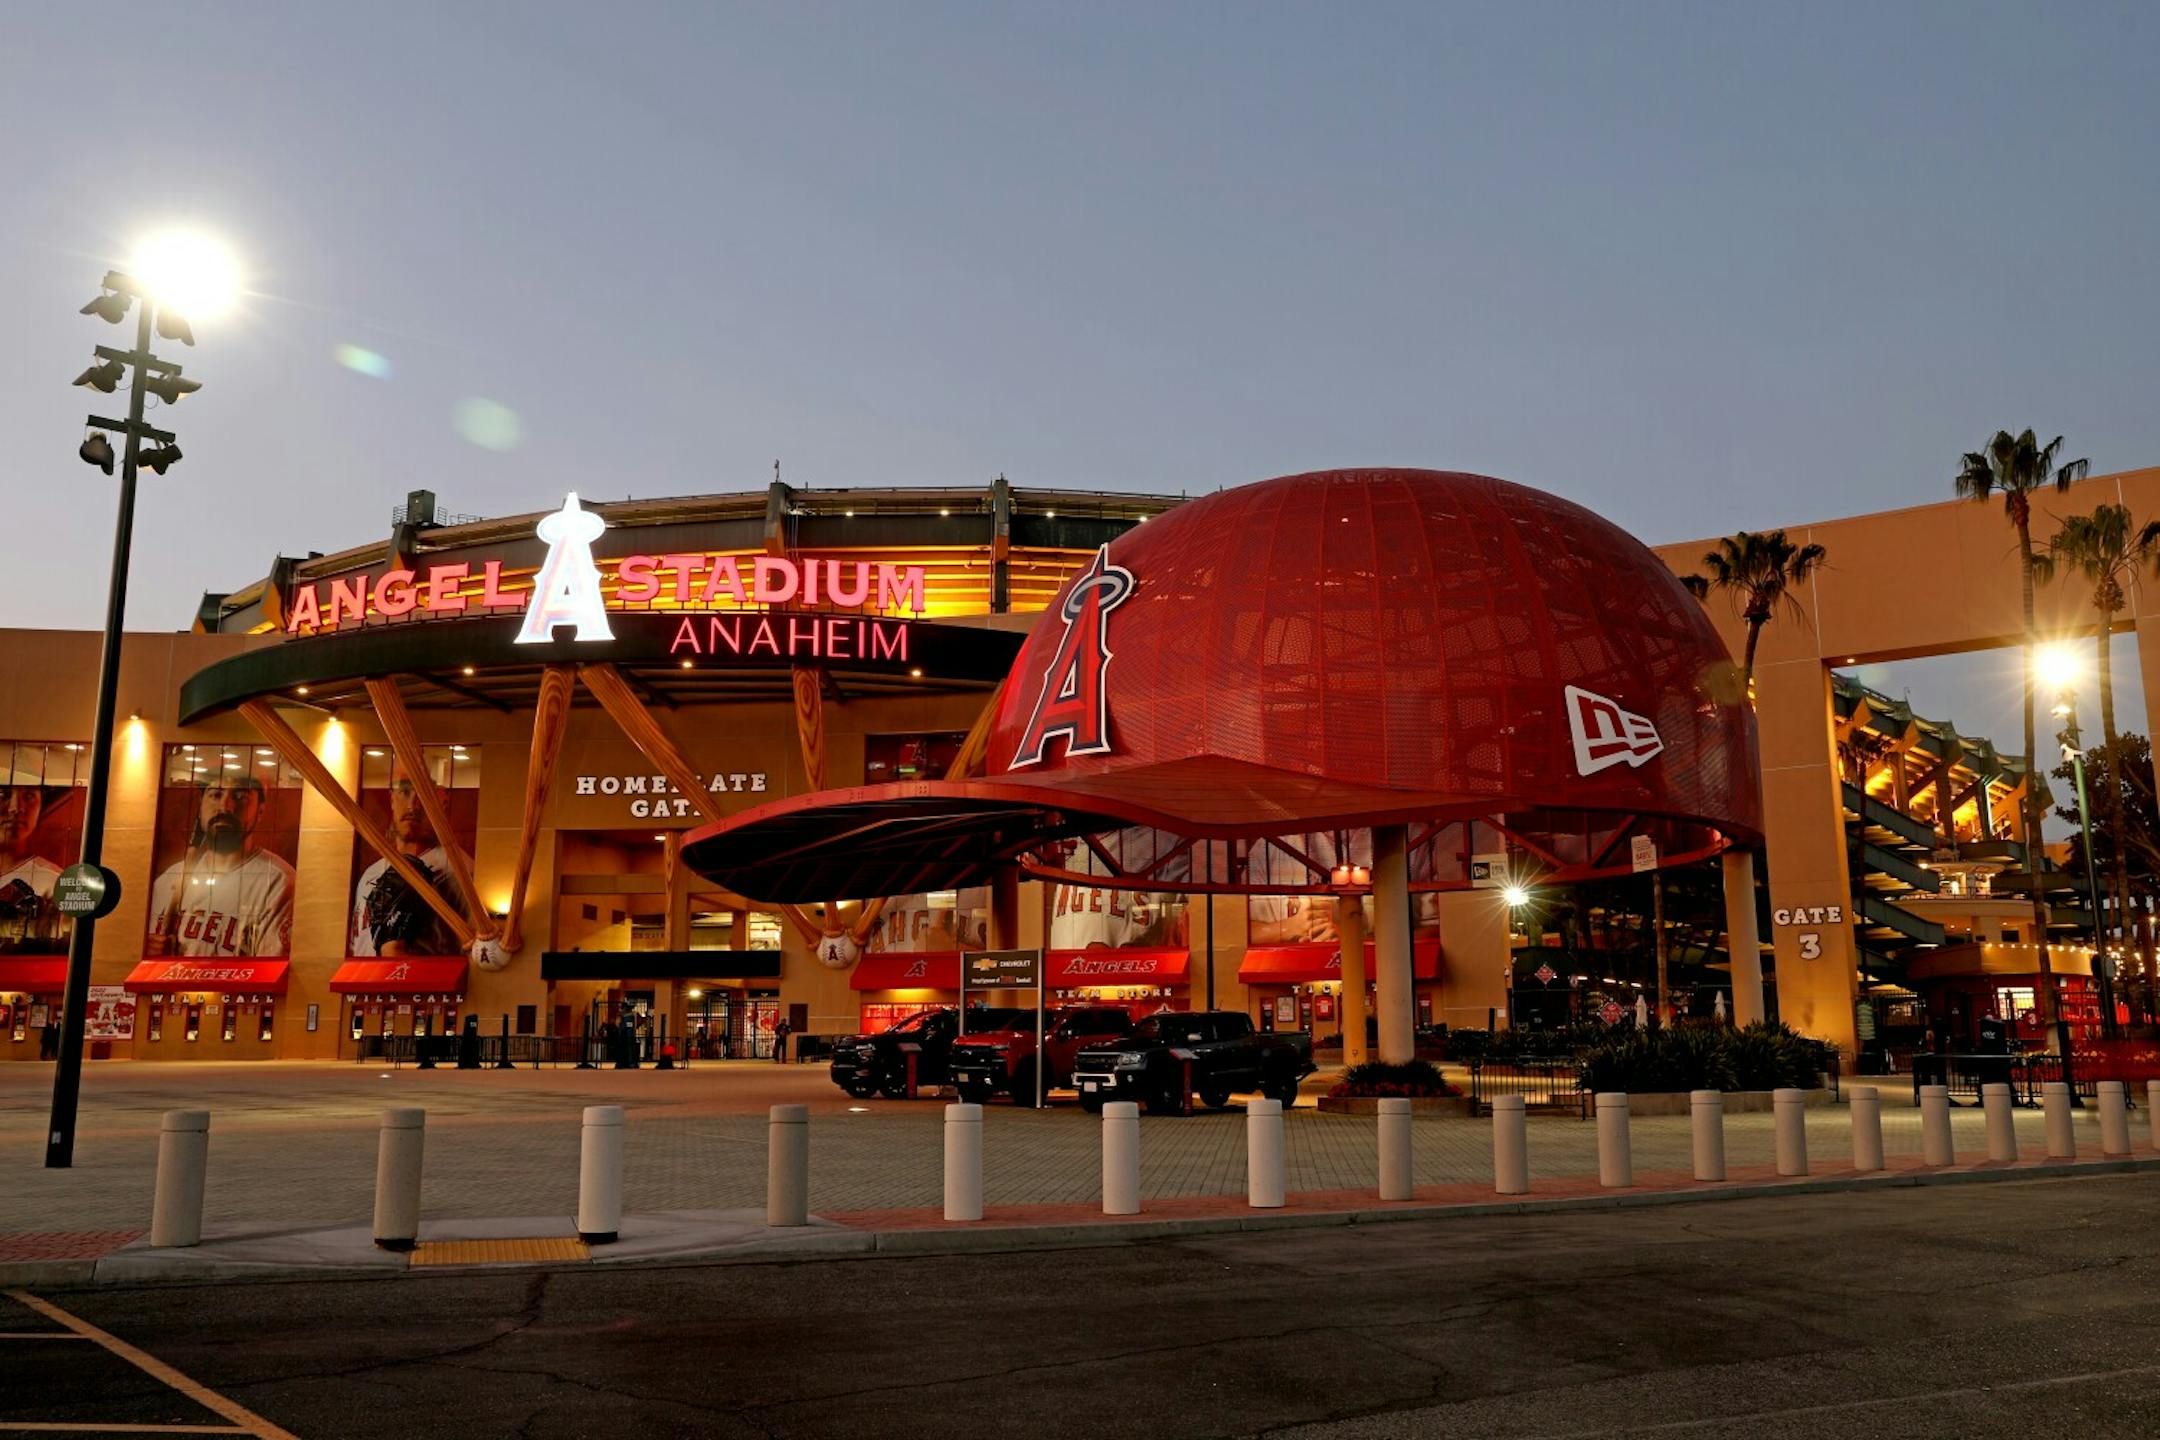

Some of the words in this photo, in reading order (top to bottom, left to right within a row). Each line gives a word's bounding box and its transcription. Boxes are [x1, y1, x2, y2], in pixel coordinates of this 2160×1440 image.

[286, 560, 528, 634] ANGEL
[615, 554, 926, 613] STADIUM
[670, 615, 908, 662] ANAHEIM
[1008, 542, 1134, 771] A
[58, 901, 96, 911] STADIUM
[64, 892, 91, 901] ANGEL
[1773, 906, 1842, 926] GATE
[1799, 933, 1821, 960] 3
[160, 962, 254, 981] ANGELS
[1062, 955, 1158, 975] ANGELS
[151, 993, 206, 1004] WILL
[221, 993, 274, 1004] CALL
[346, 993, 397, 1003] WILL
[412, 993, 464, 1003] CALL
[1055, 988, 1102, 1000] TEAM
[1116, 987, 1173, 1000] STORE
